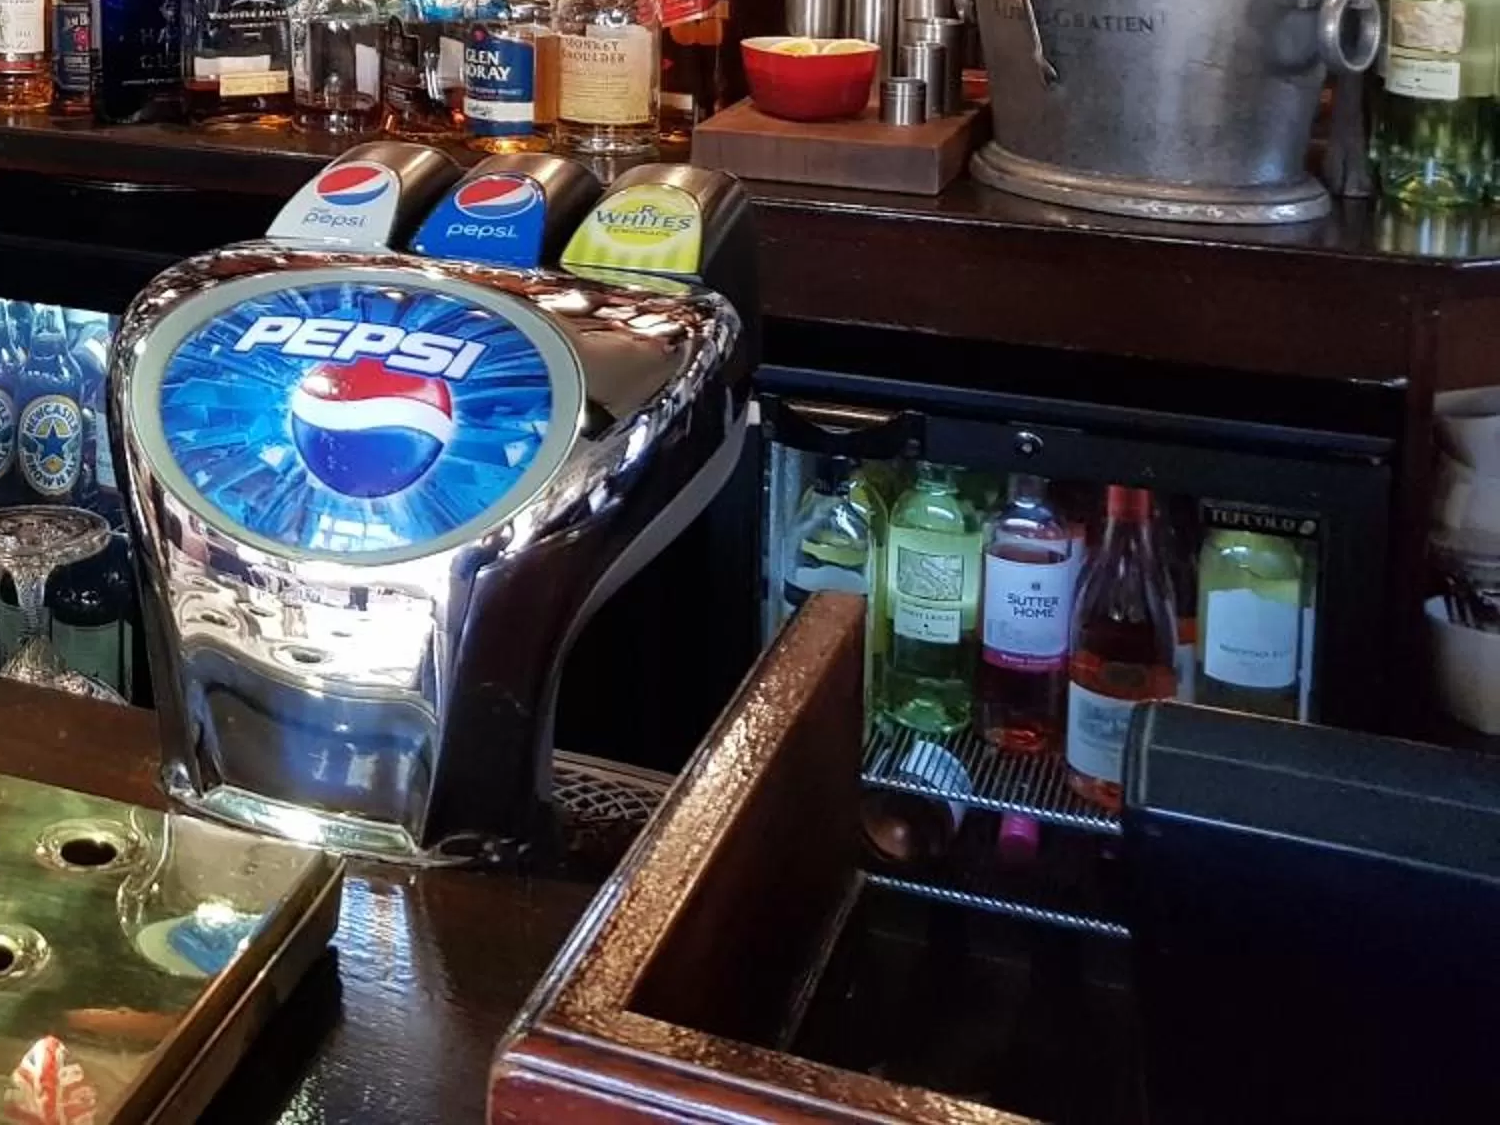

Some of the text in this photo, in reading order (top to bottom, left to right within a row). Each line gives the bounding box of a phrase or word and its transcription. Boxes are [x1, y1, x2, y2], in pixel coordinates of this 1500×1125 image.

[465, 65, 512, 82] ORAY
[233, 316, 491, 381] PEPSI
[1007, 592, 1059, 608] SUTTER
[1013, 607, 1055, 619] HOME
